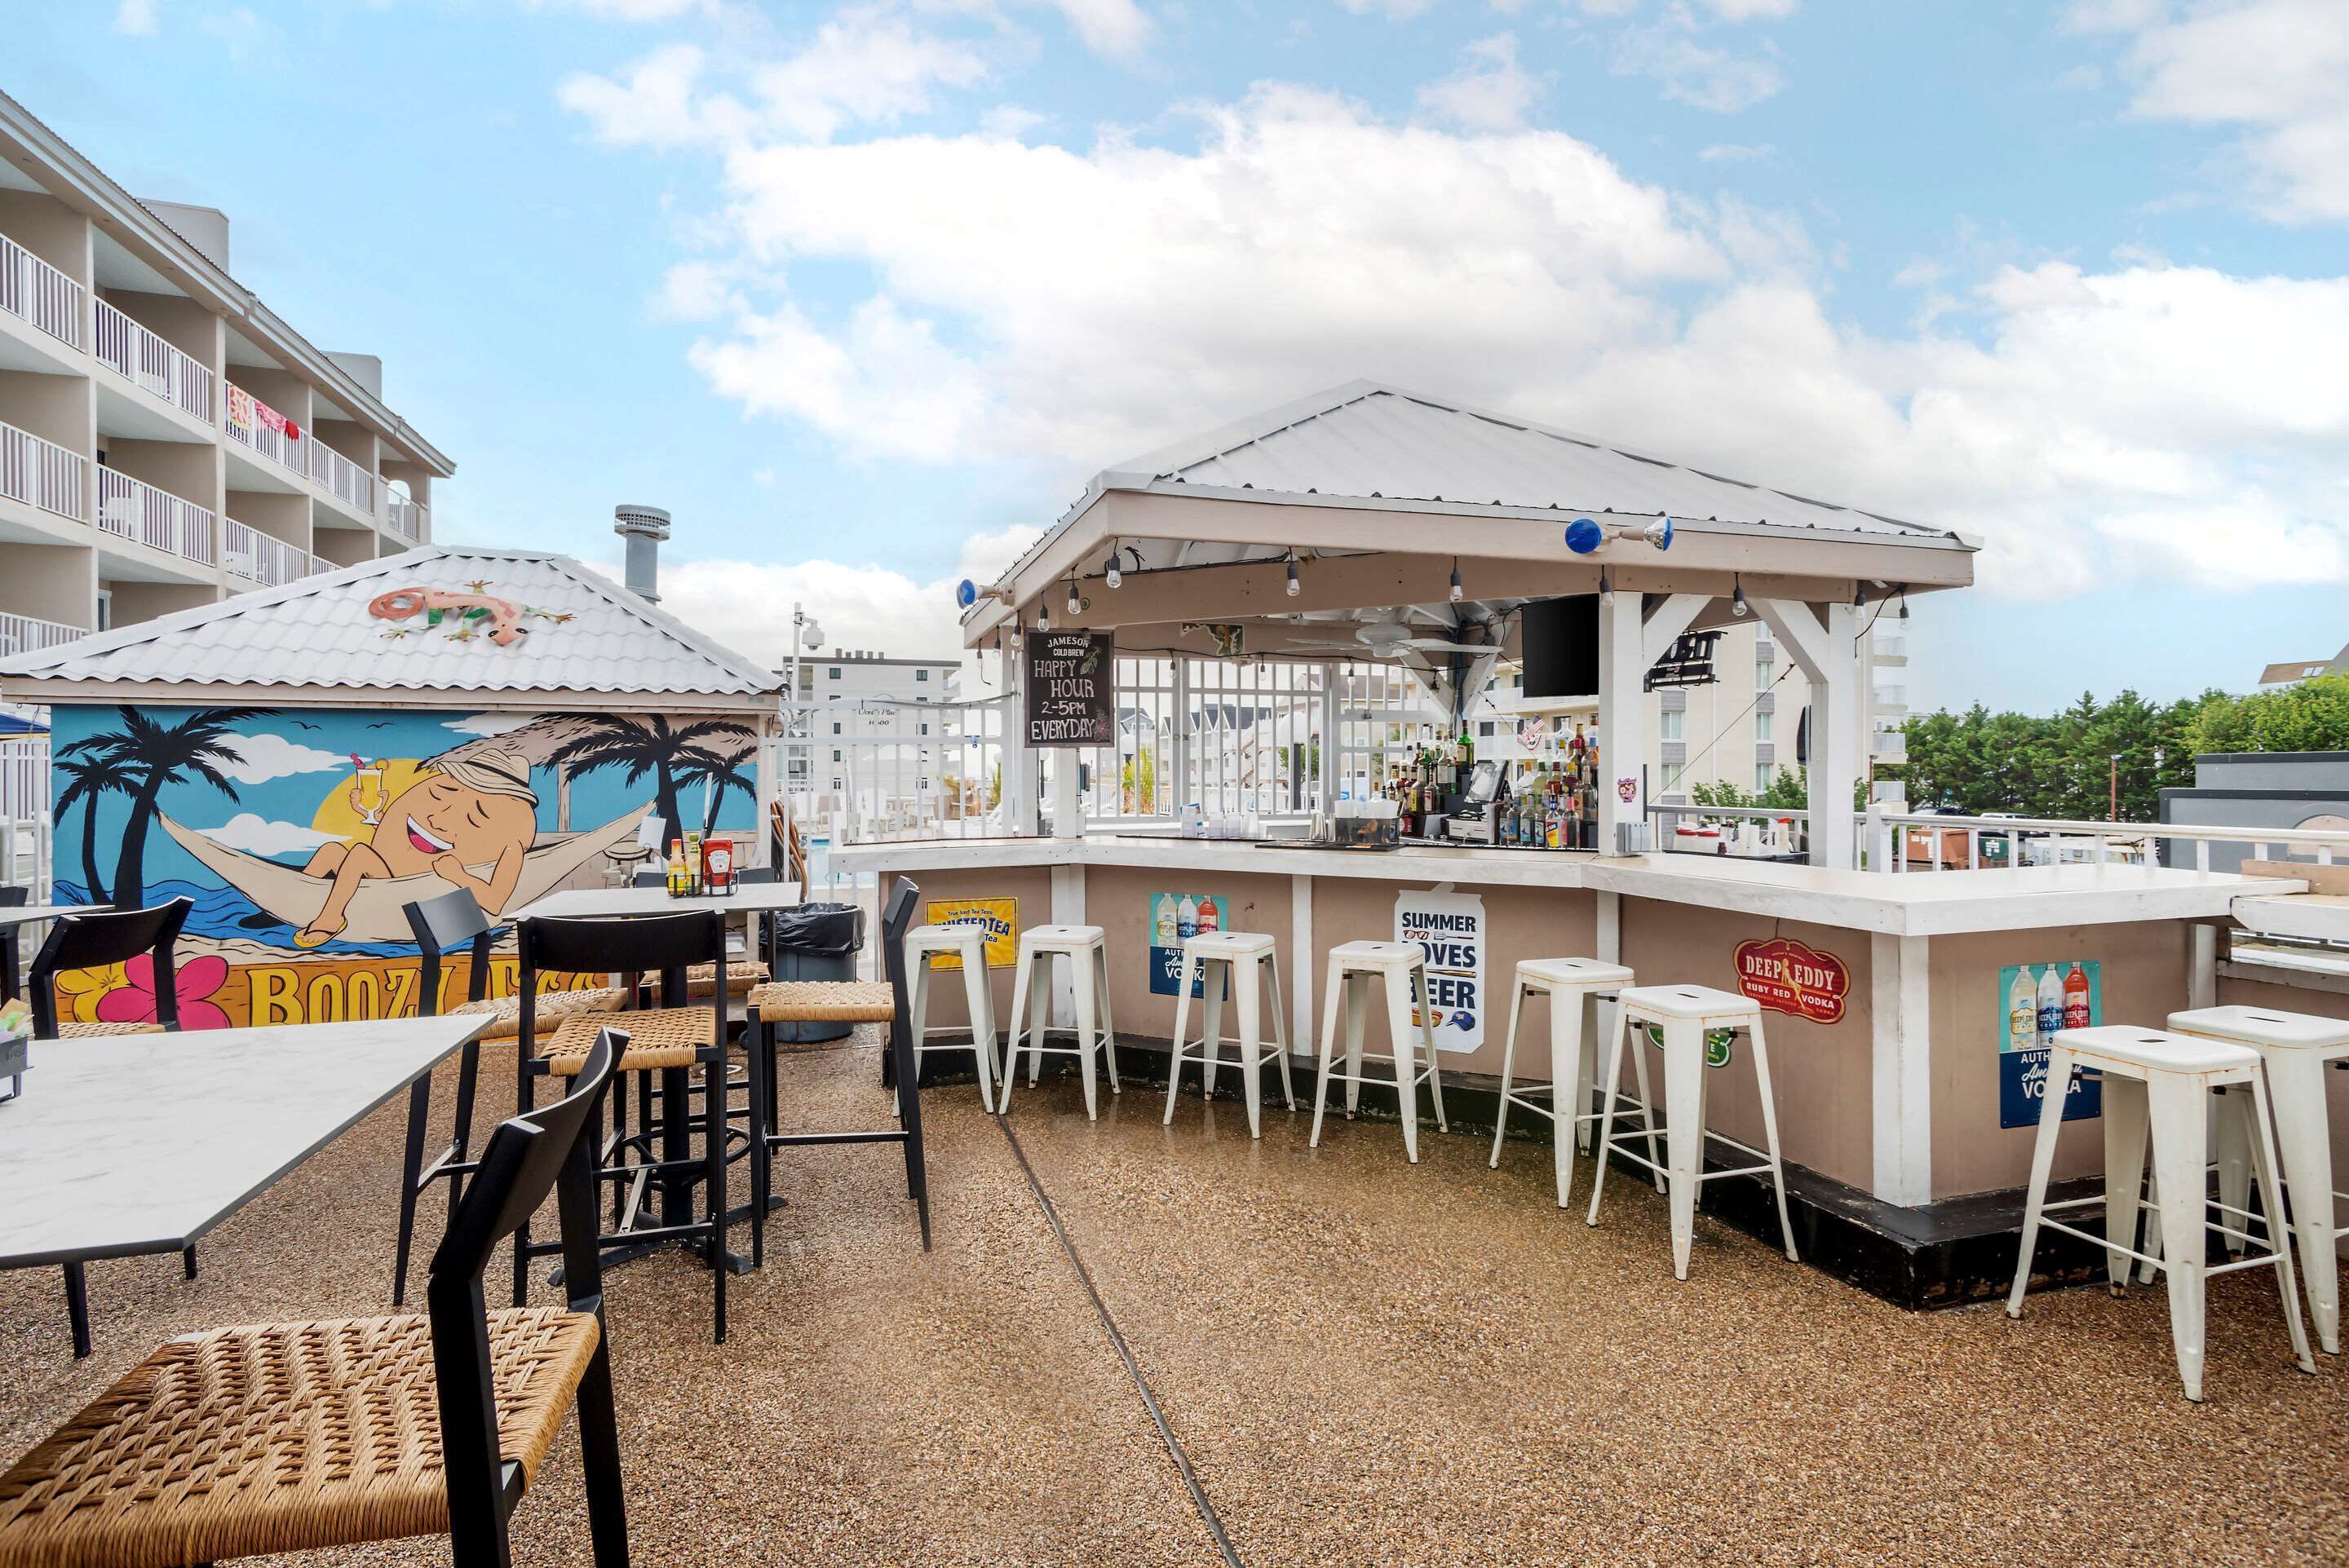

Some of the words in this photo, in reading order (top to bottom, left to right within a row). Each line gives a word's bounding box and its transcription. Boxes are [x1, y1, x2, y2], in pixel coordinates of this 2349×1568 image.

[1047, 637, 1090, 648] JAMESON
[1068, 649, 1085, 657] BREW
[1034, 660, 1077, 678] HAPPY
[1051, 679, 1095, 698] HOUR
[1042, 700, 1086, 715] 2-5PM
[1031, 718, 1095, 740] EVERYDAY
[989, 917, 1011, 936] TEA
[1402, 912, 1476, 932] SUMMER
[984, 934, 998, 943] Tea
[1745, 955, 1781, 978] DEEP
[1794, 965, 1835, 991] EDDY
[1746, 983, 1769, 994] RUBY
[1772, 988, 1790, 998] RED
[1801, 994, 1834, 1009] VODKA
